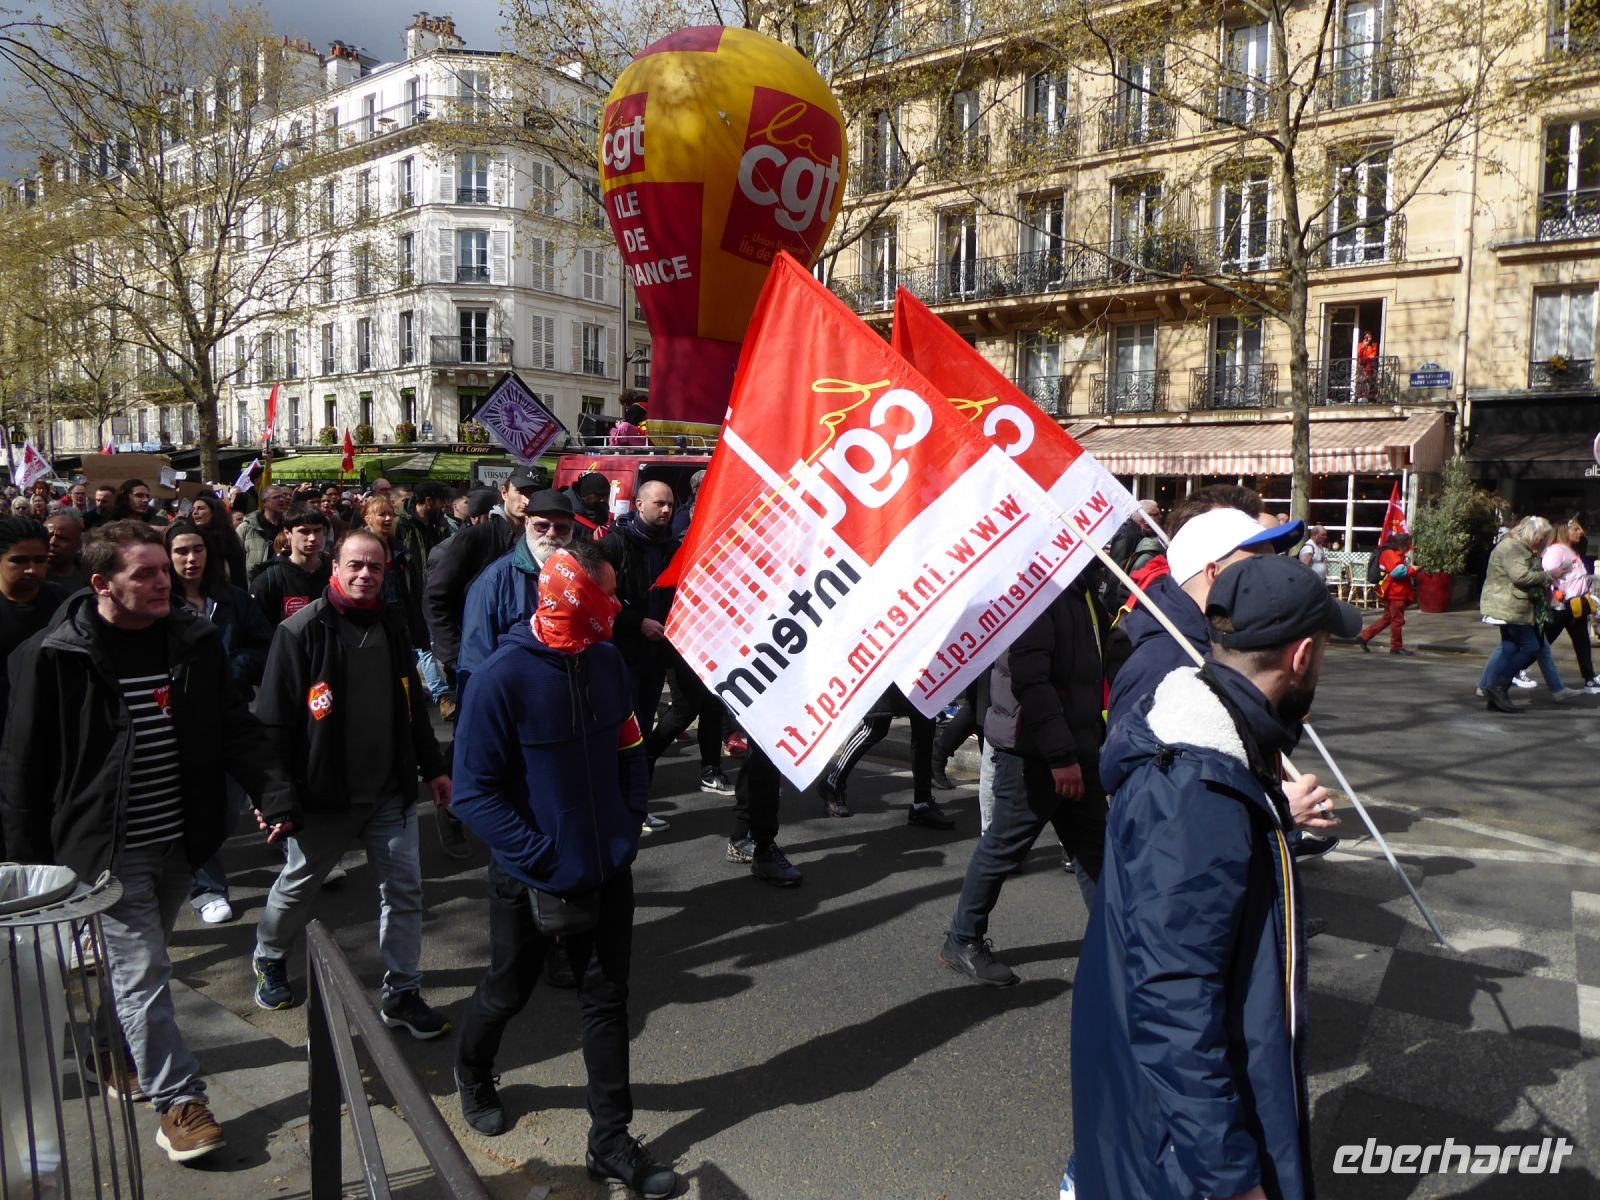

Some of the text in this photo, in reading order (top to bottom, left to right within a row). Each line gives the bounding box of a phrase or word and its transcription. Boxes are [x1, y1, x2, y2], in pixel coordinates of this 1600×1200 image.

[602, 116, 645, 170] cgt
[750, 102, 840, 167] la
[738, 144, 840, 232] cgt
[614, 191, 641, 219] ILE
[624, 227, 649, 253] DE
[625, 255, 692, 287] RANCE
[484, 470, 509, 479] VERSACE
[555, 563, 575, 581] cgt
[310, 690, 333, 711] cgt
